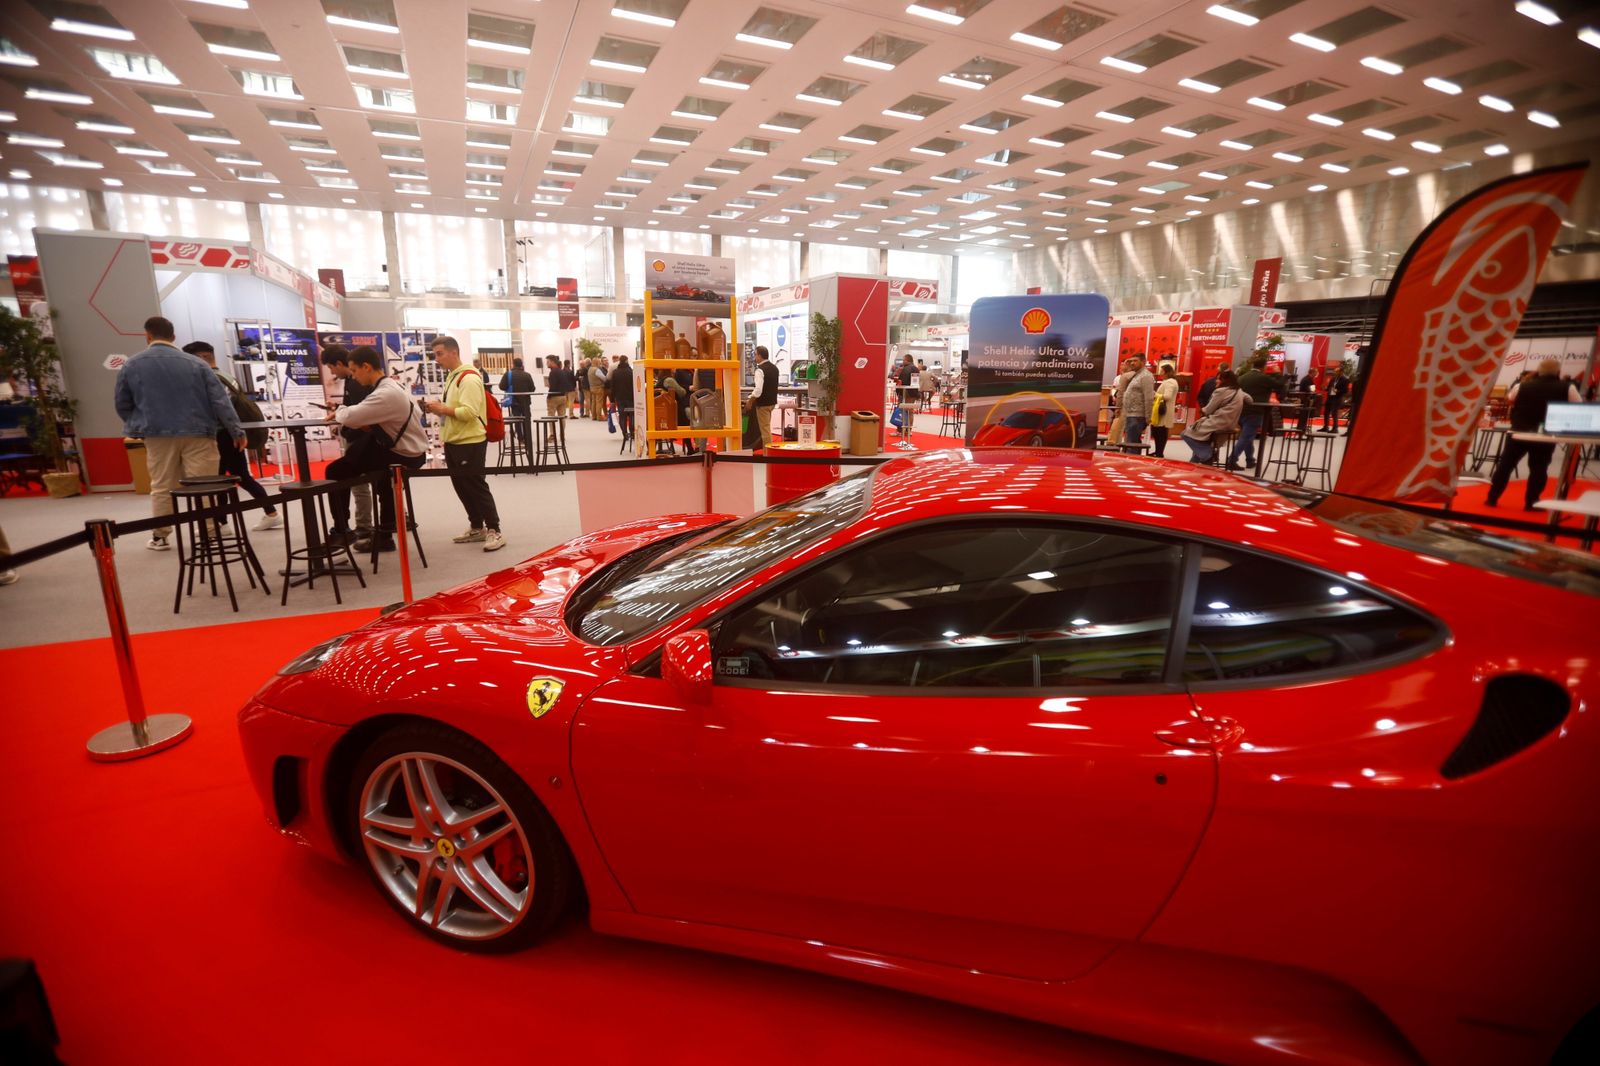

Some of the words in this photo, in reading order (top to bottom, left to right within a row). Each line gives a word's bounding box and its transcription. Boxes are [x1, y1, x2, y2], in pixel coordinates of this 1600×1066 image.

[1261, 270, 1270, 292] Peña
[984, 346, 1007, 355] Shell
[1009, 346, 1035, 356] Helix
[1038, 346, 1065, 356] Ultra
[1067, 347, 1090, 358] 0W,
[978, 359, 1020, 369] potencia
[1022, 360, 1029, 370] y
[1031, 359, 1094, 370] rendimiento
[1047, 371, 1074, 379] utilizarlo
